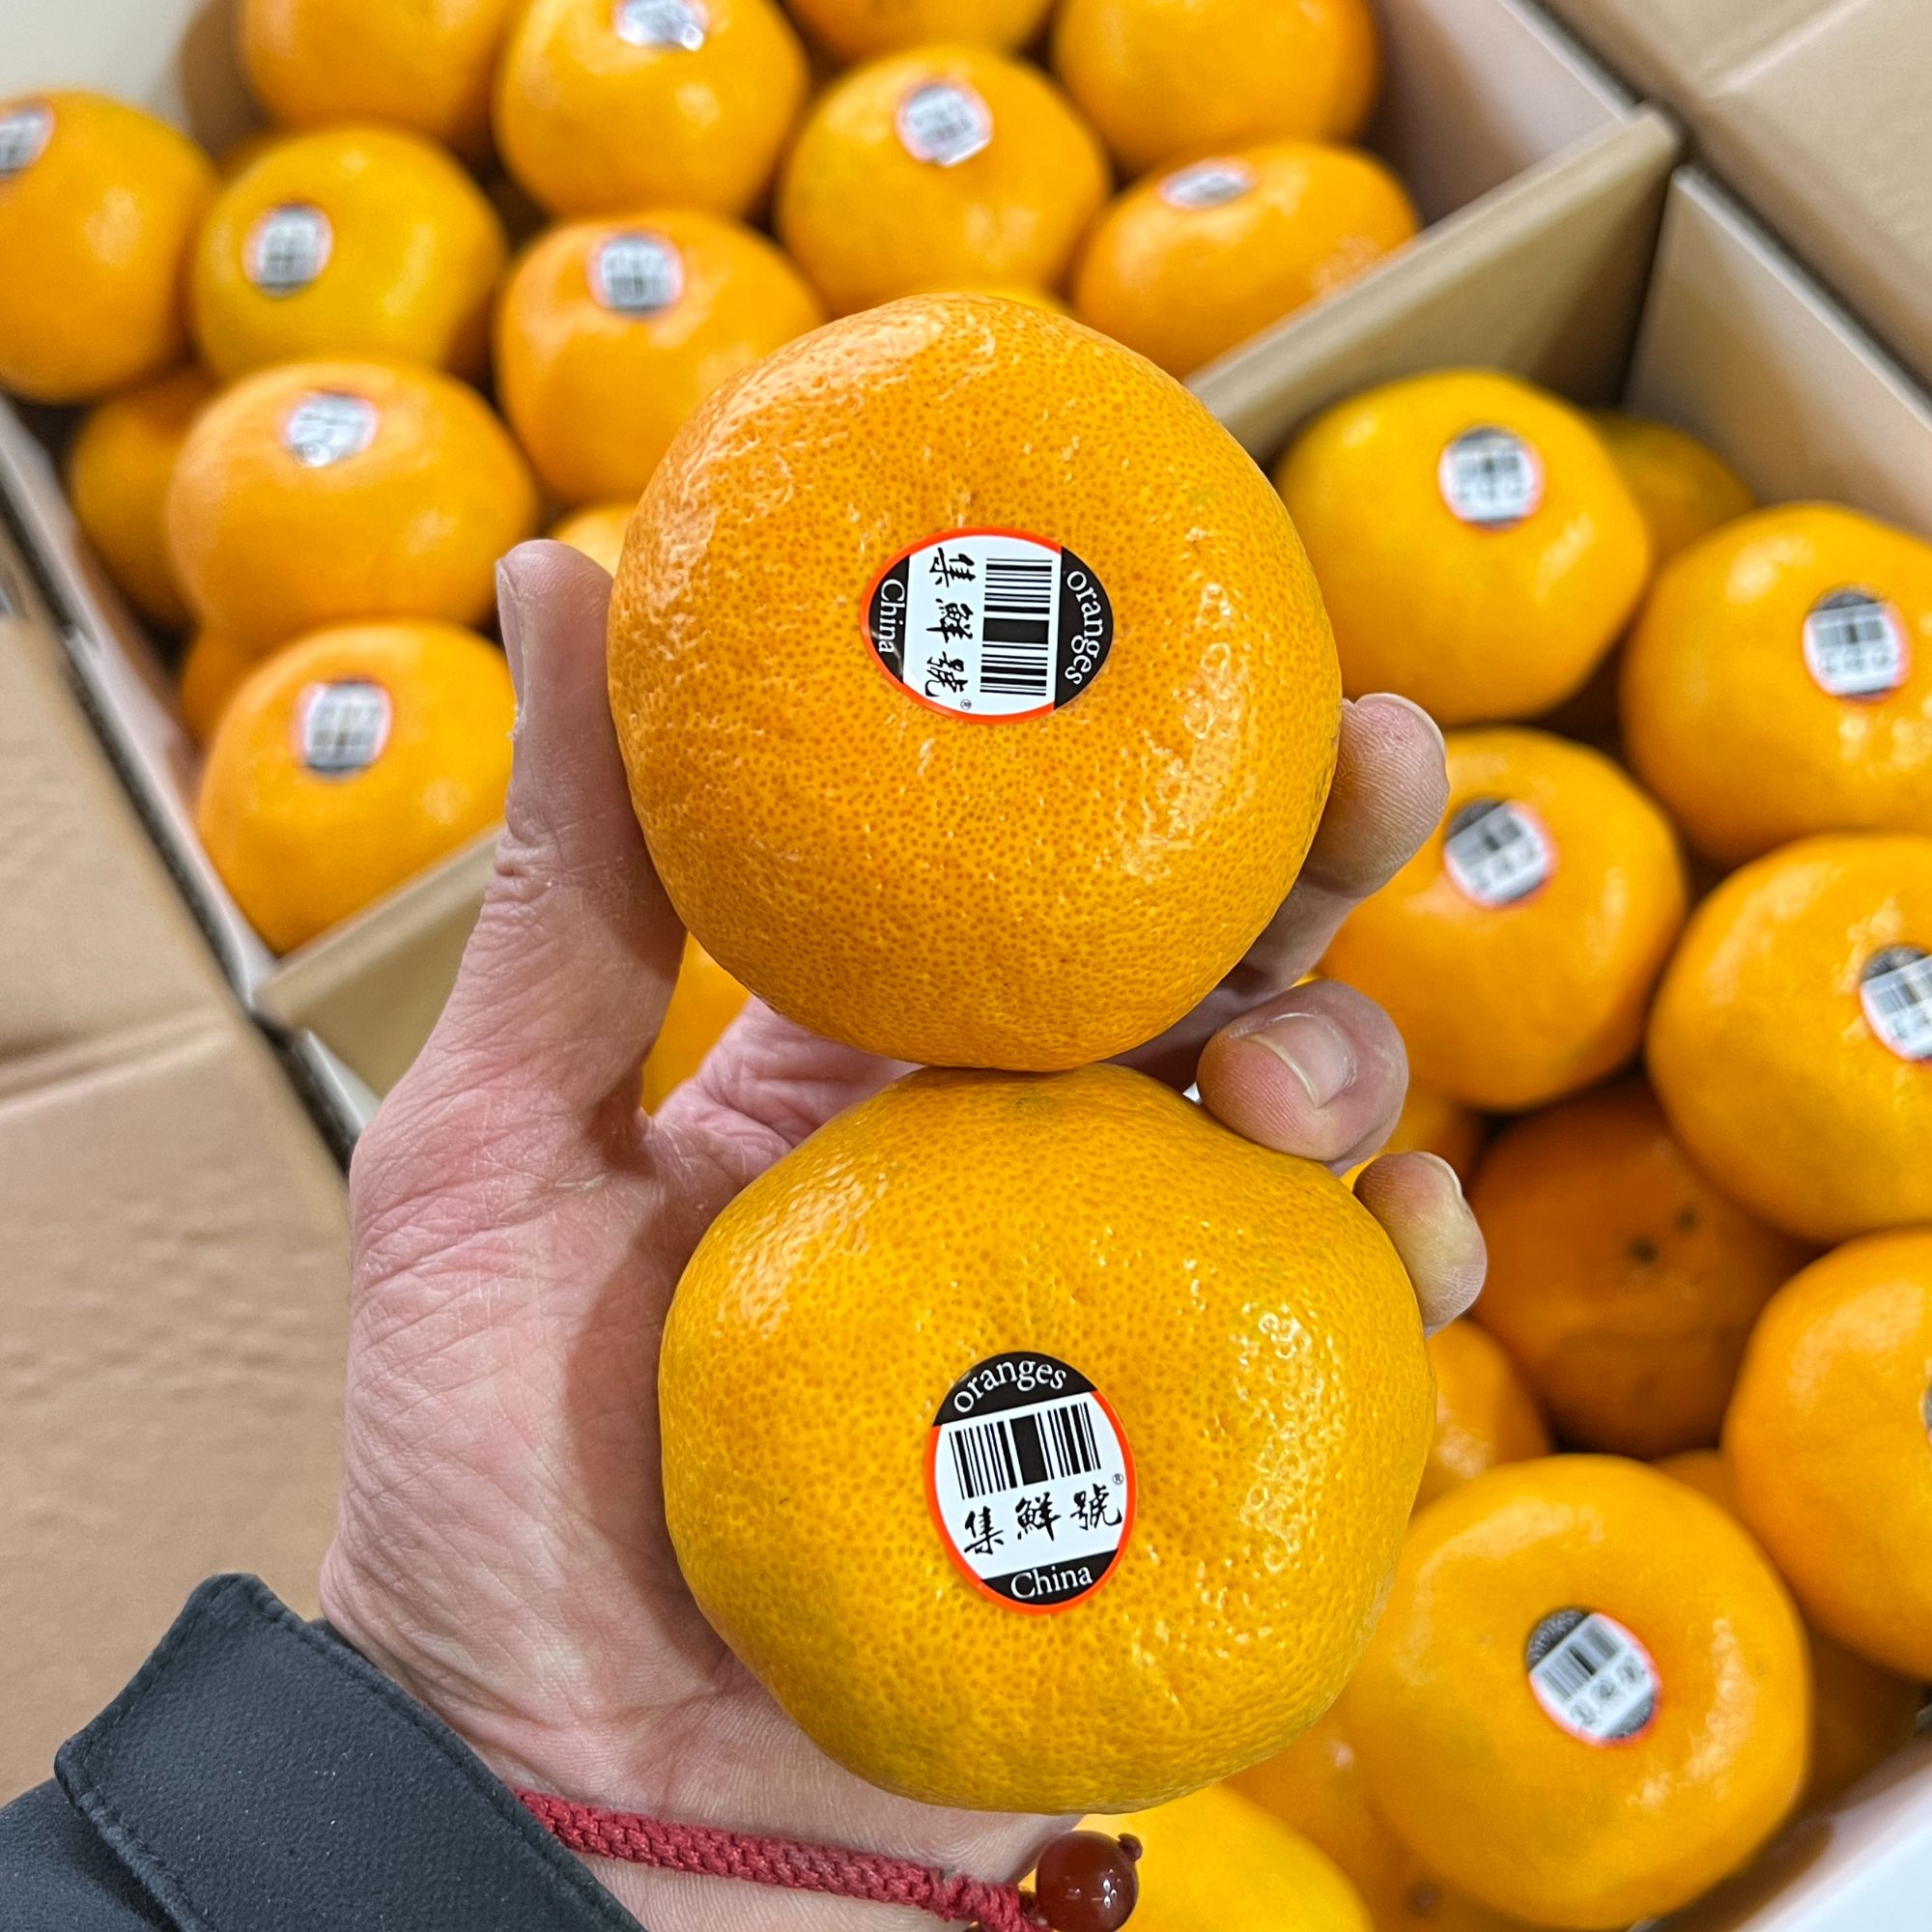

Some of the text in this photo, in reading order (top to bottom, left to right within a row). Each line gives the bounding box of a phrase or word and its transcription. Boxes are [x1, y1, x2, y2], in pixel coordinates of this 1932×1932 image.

[878, 579, 905, 654] China
[1065, 570, 1103, 685] oranges
[953, 1360, 1066, 1413] oranges
[963, 1483, 1122, 1555] 集鮮號
[1010, 1566, 1093, 1599] China
